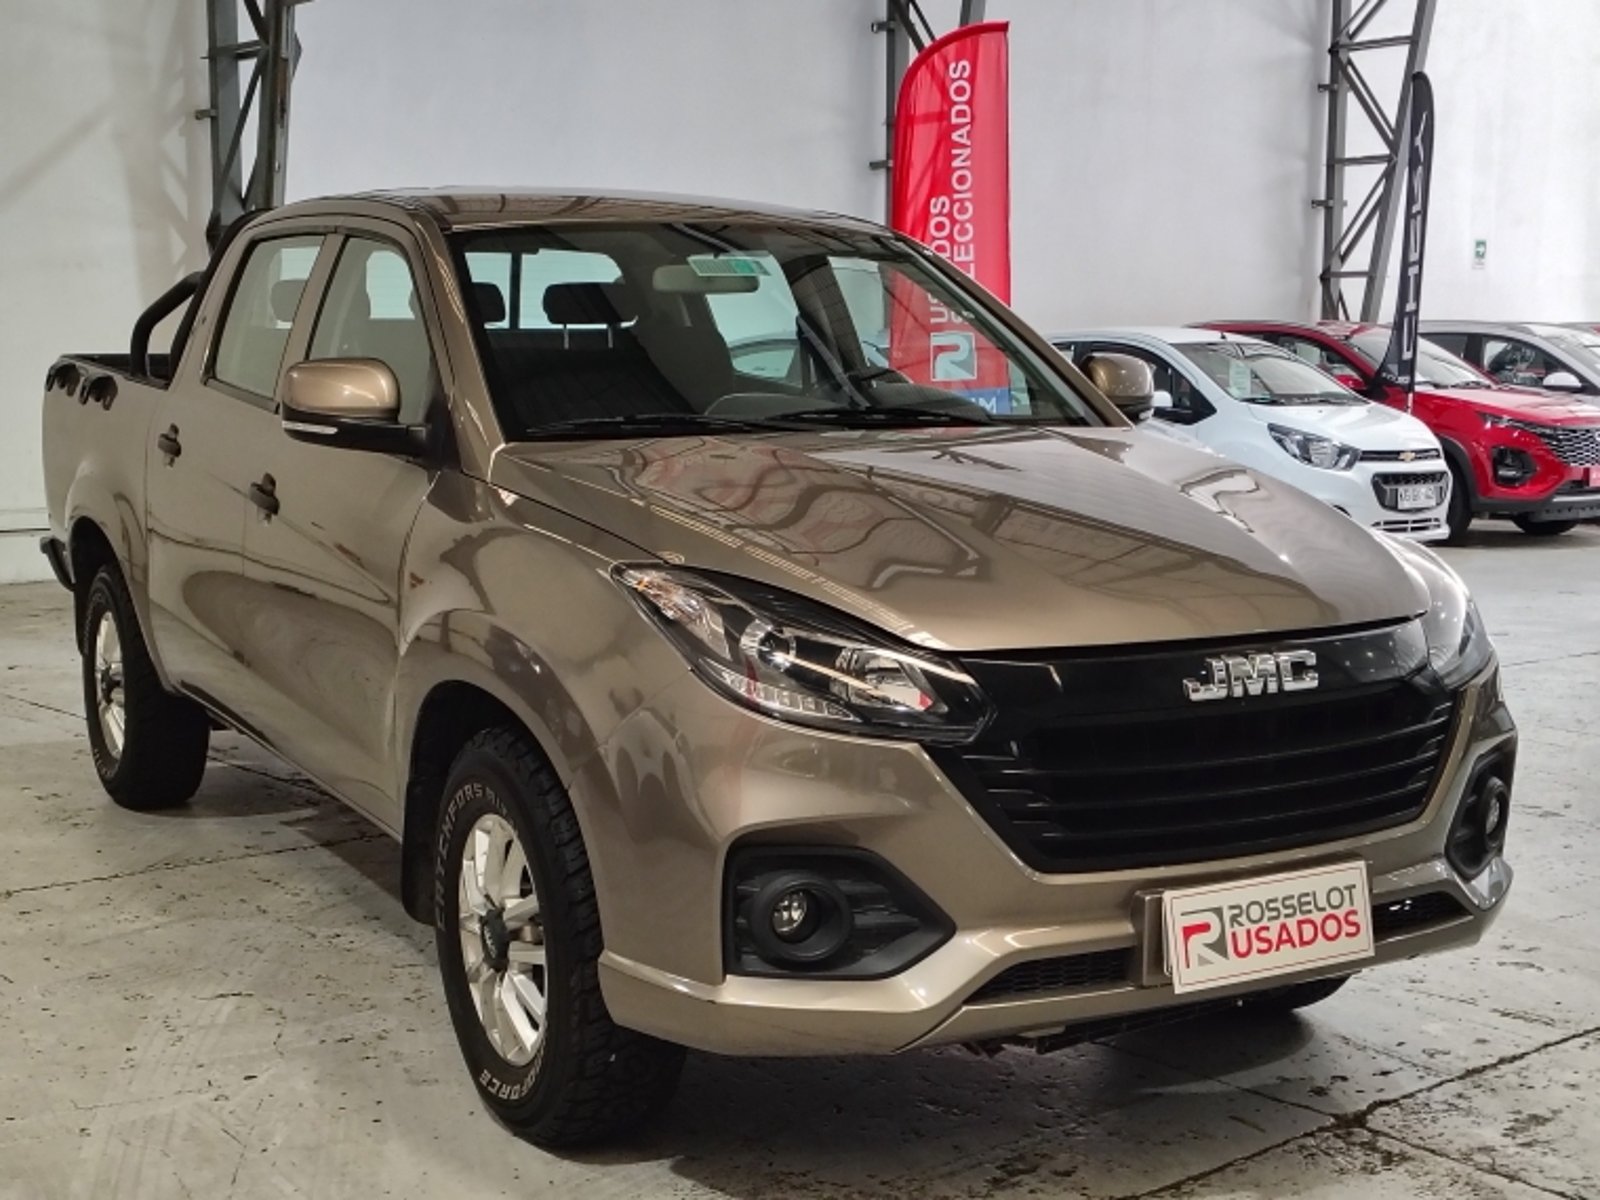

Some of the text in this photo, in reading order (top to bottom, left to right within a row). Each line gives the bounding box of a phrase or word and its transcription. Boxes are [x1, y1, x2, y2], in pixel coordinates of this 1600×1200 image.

[1182, 649, 1319, 701] JMC
[1228, 884, 1357, 929] ROSSELOT
[1231, 909, 1361, 959] USADOS
